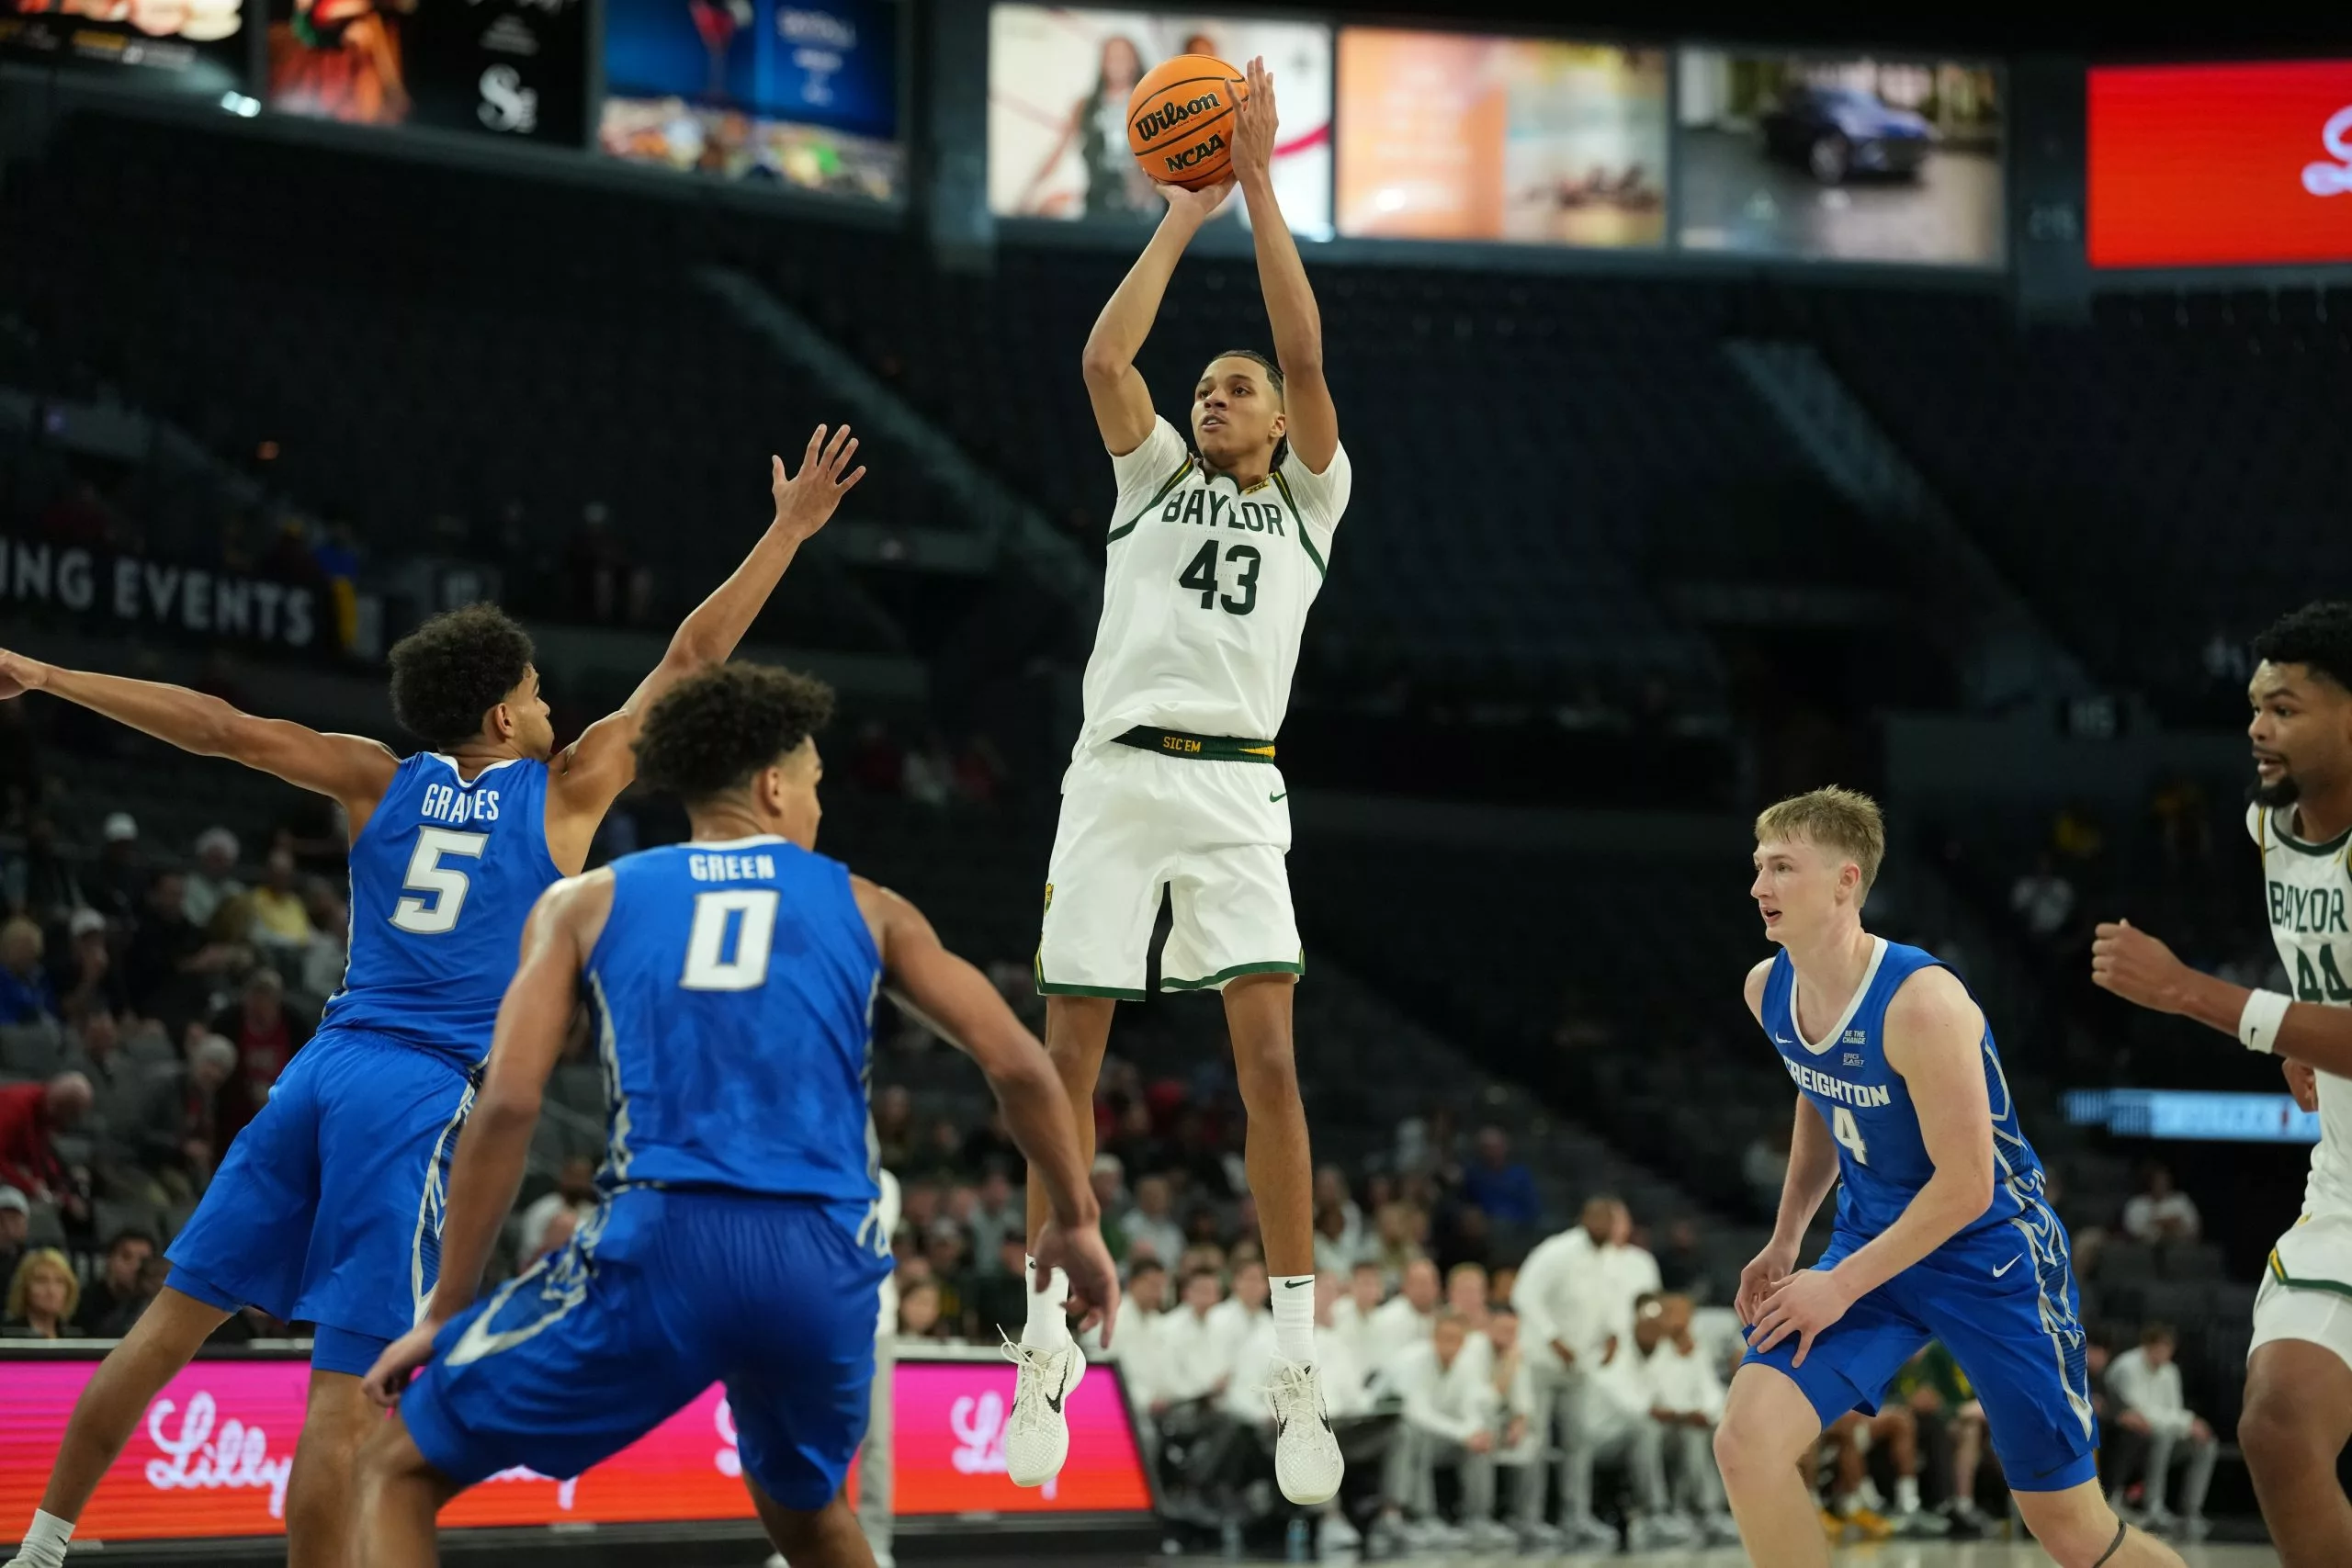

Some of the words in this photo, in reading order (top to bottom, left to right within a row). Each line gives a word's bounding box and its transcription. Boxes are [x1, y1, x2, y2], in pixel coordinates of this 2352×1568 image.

[1135, 92, 1221, 141] Wilson
[1165, 133, 1227, 173] NCAA
[1161, 489, 1285, 537] BAYLOR
[113, 555, 316, 644] EVENTS
[1178, 539, 1261, 615] 43
[421, 783, 500, 823] GRAVES
[388, 825, 490, 934] 5
[689, 853, 775, 882] GREEN
[680, 888, 782, 992] 0
[2297, 942, 2352, 1003] 44
[1854, 1030, 1866, 1038] THE
[1833, 1105, 1869, 1167] 4
[145, 1390, 293, 1518] Lilly
